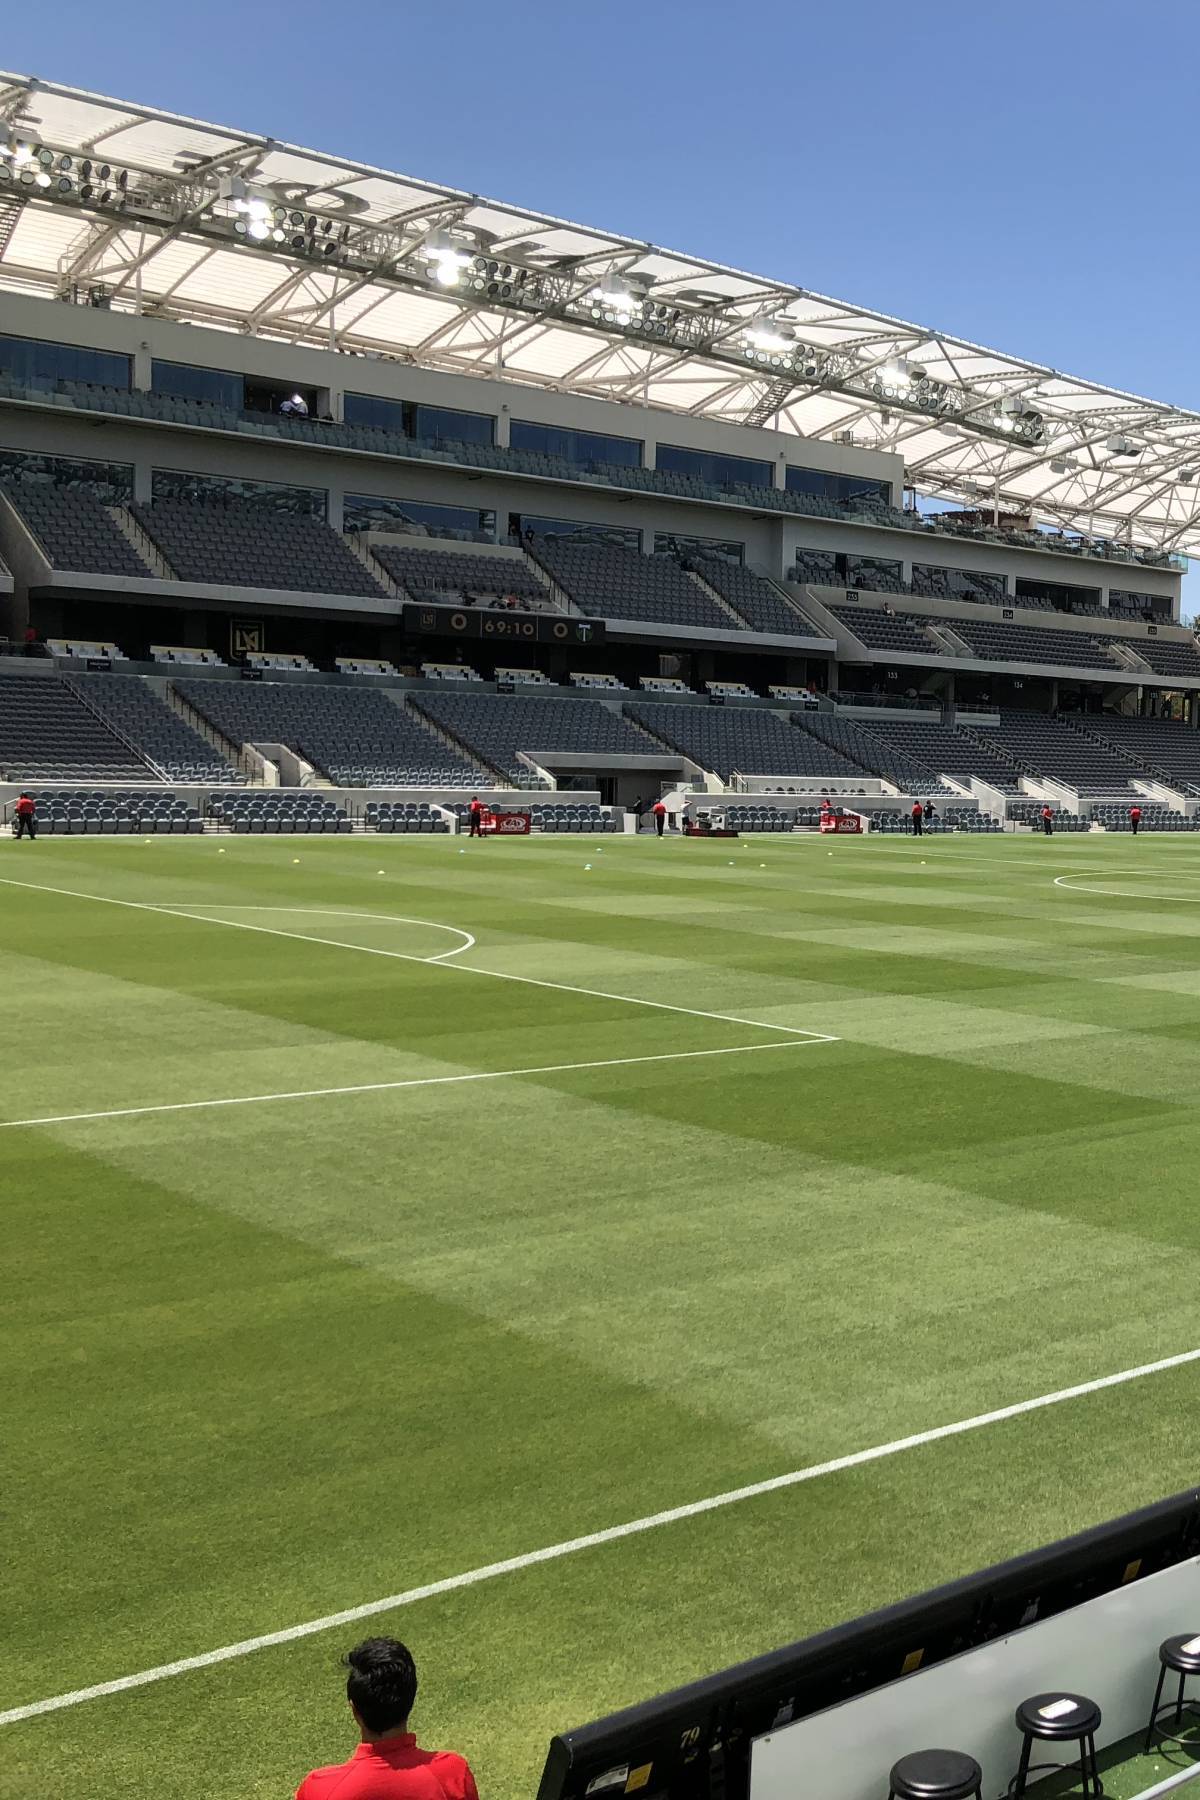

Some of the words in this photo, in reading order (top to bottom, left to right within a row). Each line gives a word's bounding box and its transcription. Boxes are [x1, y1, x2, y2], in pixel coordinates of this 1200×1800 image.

[451, 613, 467, 630] 0
[485, 620, 534, 635] 69:10
[553, 622, 568, 638] 0
[680, 1726, 701, 1749] 79
